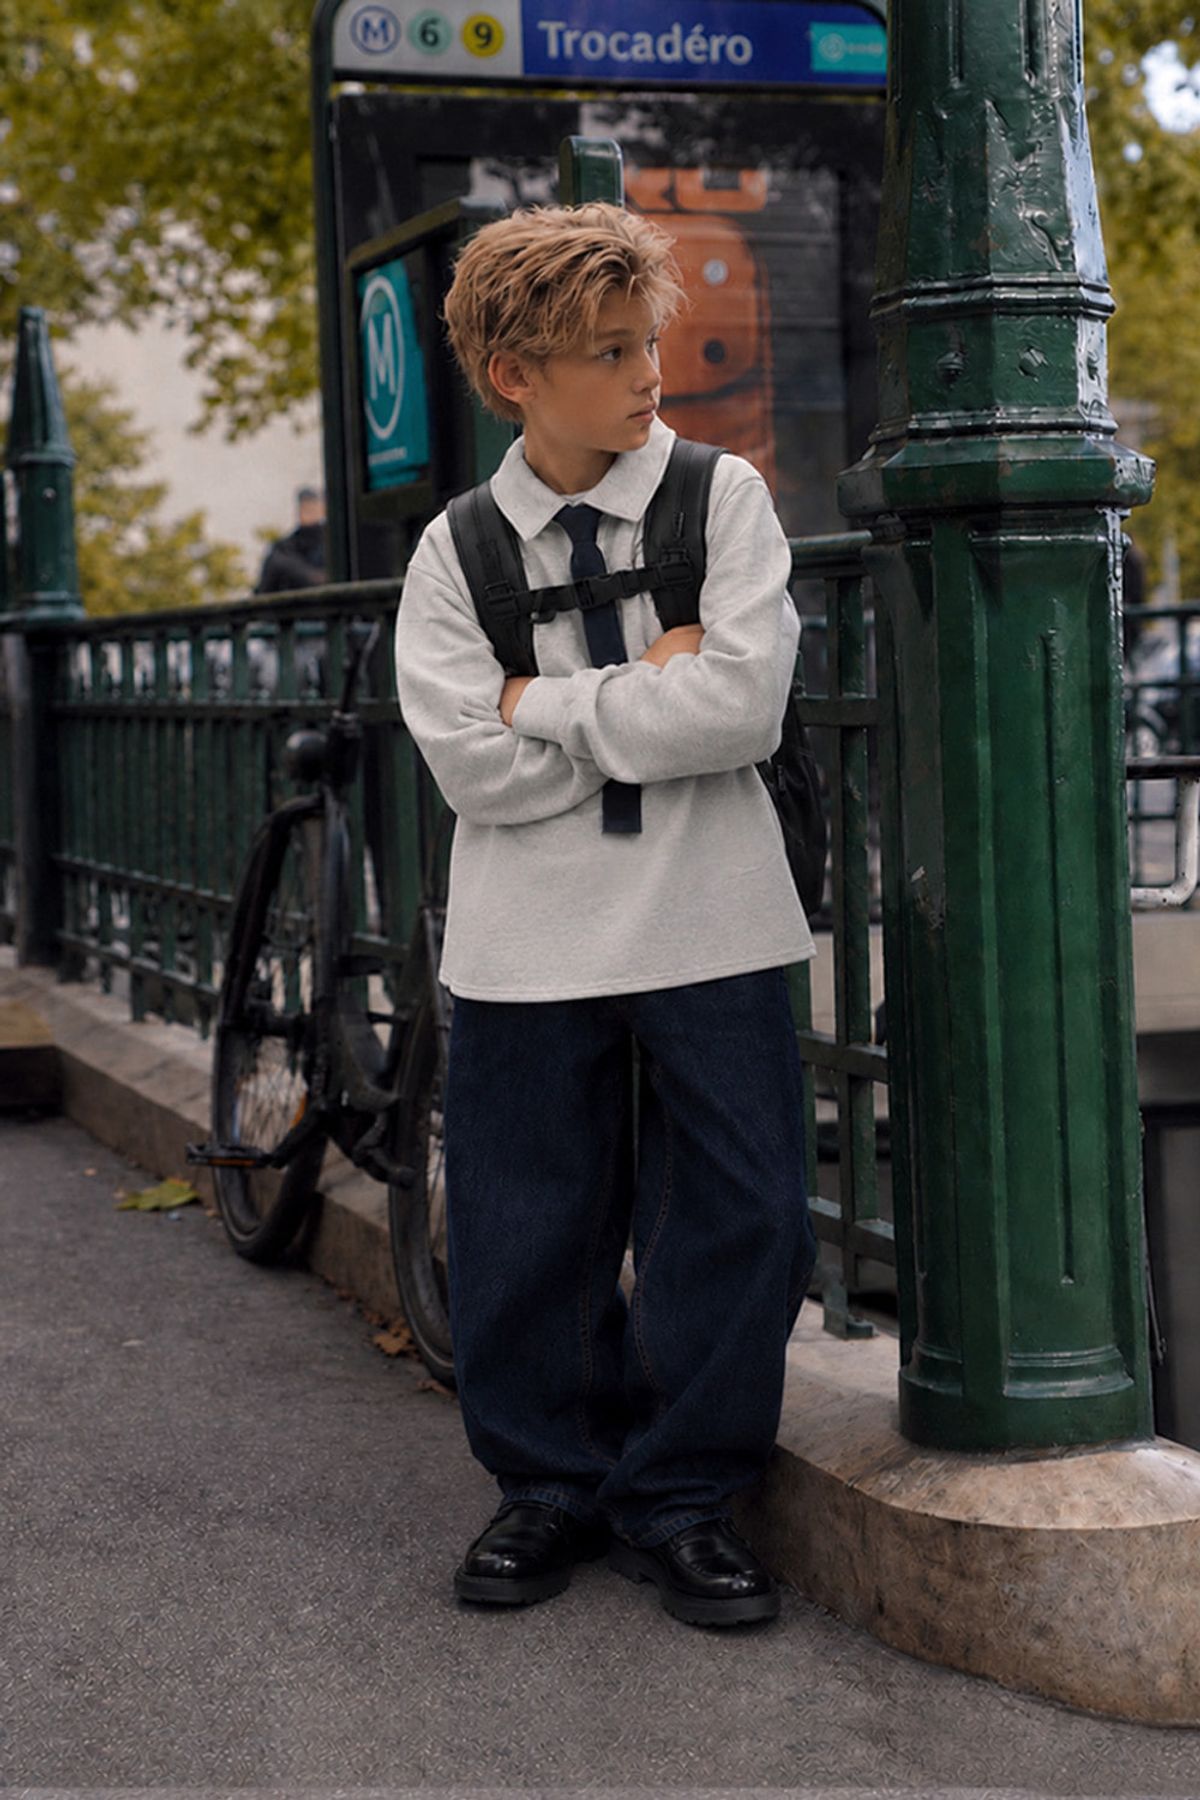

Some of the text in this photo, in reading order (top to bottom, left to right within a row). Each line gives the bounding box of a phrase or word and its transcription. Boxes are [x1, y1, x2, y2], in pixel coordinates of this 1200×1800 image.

[362, 17, 753, 66] M 6 9 Trocadéro
[367, 312, 396, 401] M
